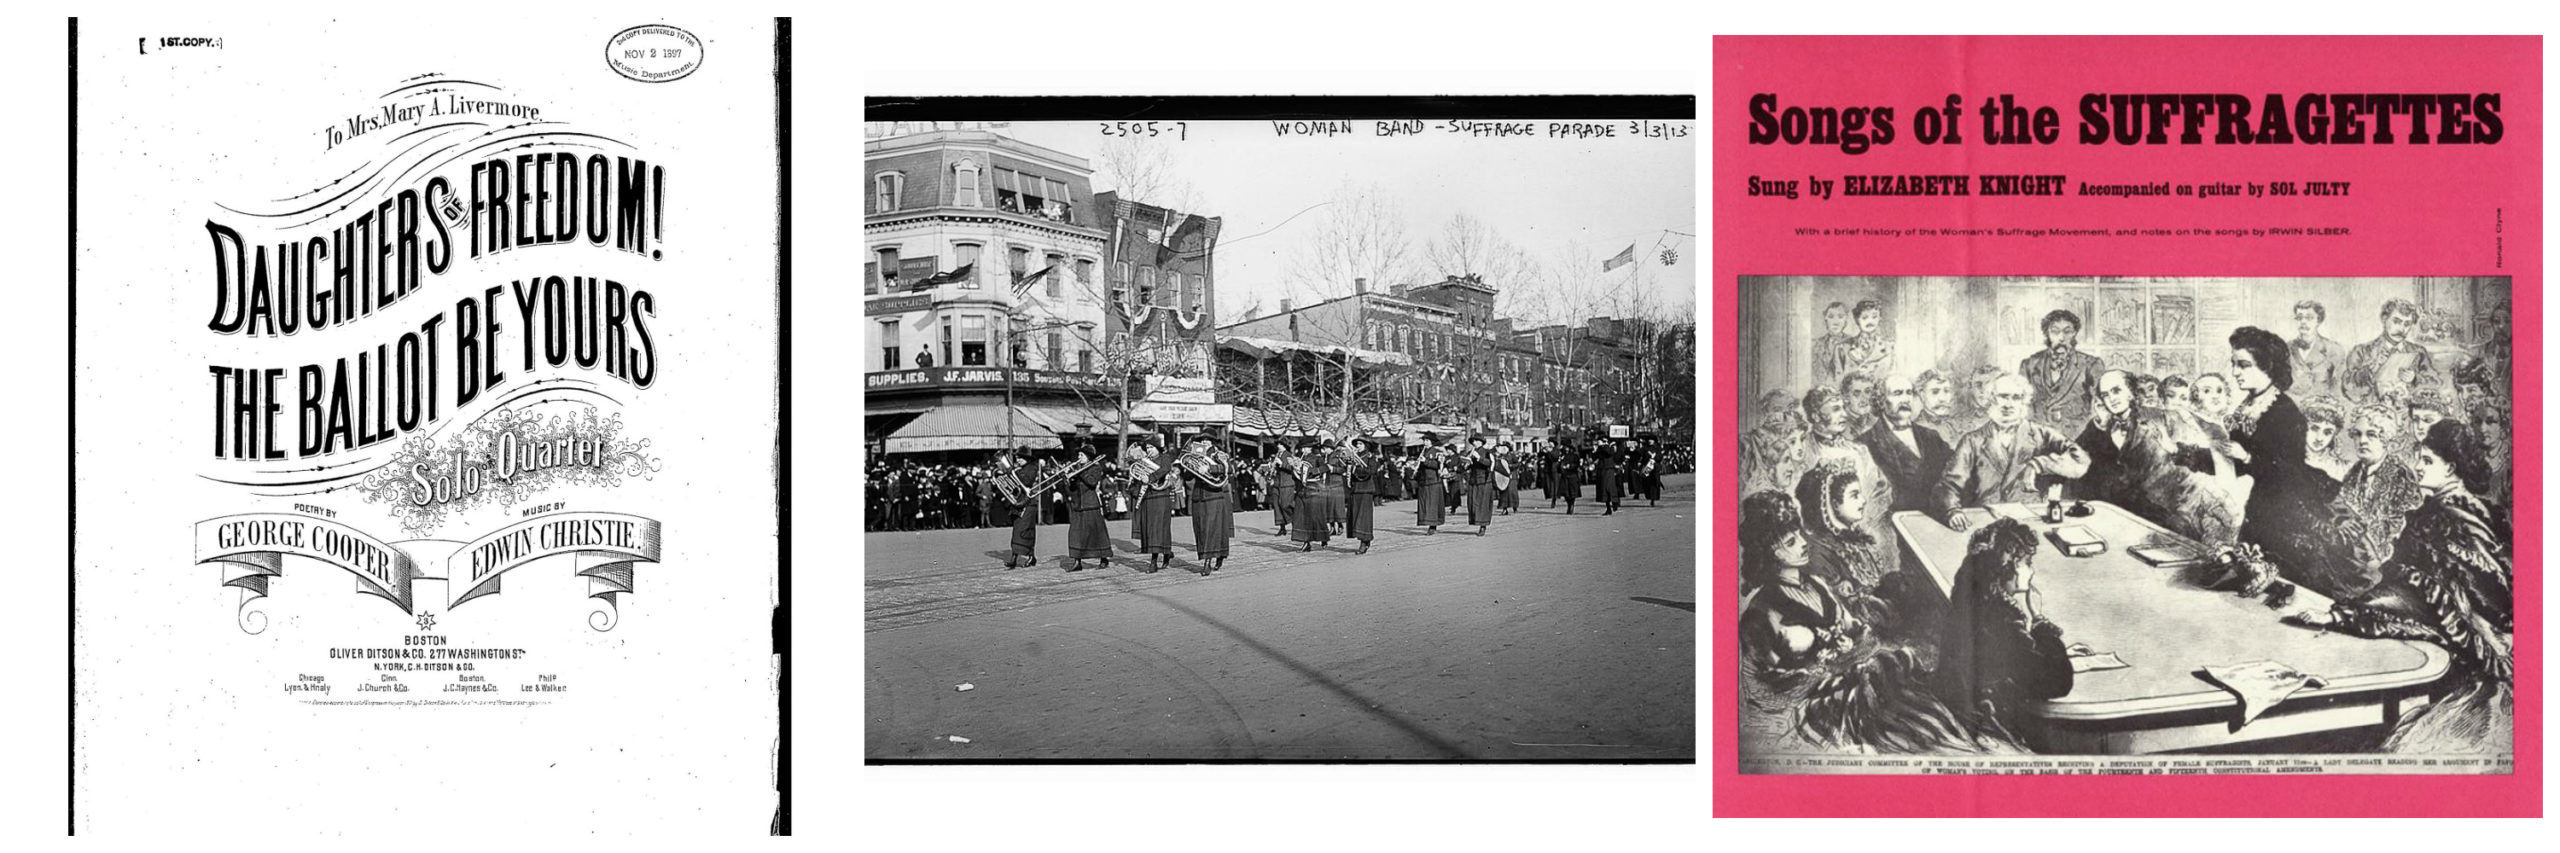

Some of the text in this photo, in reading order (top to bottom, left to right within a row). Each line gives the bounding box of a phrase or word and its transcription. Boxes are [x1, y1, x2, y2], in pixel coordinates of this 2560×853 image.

[642, 28, 675, 37] DELIVERED
[676, 32, 685, 40] TO
[685, 37, 695, 47] THE
[624, 49, 645, 59] NOV
[650, 48, 657, 58] 2
[613, 59, 638, 76] Music
[325, 126, 342, 150] To
[381, 103, 426, 127] Mary
[429, 96, 446, 117] A.
[449, 94, 543, 122] Livermore.
[1273, 119, 1353, 136] WOMAN
[1376, 119, 1424, 136] BAND
[1549, 122, 1616, 138] PARADE
[1748, 92, 2505, 155] Songs of the SUFFRAGETTES
[1100, 121, 1186, 141] 2505-7
[1748, 175, 2351, 200] Sung by ELIZABETH KNIGHT Accompanied on guitar by SOL JULTY
[1794, 228, 1820, 236] With
[1834, 228, 1860, 236] brief
[1863, 228, 1901, 238] history
[1904, 228, 1916, 236] of
[1919, 228, 1937, 236] the
[1940, 228, 1993, 236] Woman's
[1997, 228, 2046, 238] Suffrage
[2049, 228, 2112, 237] Movement,
[2115, 228, 2137, 236] and
[2193, 228, 2212, 236] the
[2215, 230, 2249, 238] songs
[2252, 228, 2267, 238] by
[2268, 228, 2302, 236] IRWIN
[205, 151, 666, 337] DAUGHTERS OF FREEDOM!
[209, 275, 656, 461] THE BALLOT BE YOURS
[411, 449, 480, 507] Solo
[498, 430, 603, 486] Quartet
[294, 503, 337, 518] POETRY BY
[522, 502, 566, 517] MUSIC BY
[218, 520, 305, 549] GEORGE
[471, 519, 641, 583] EDWIN CHRISTIE.
[404, 635, 447, 646] BOSTON
[329, 648, 364, 659] OLIVER
[429, 648, 446, 659] 277
[447, 648, 511, 659] WASHINGTON
[424, 663, 454, 671] DITSON
[456, 663, 462, 671] &
[299, 673, 325, 684] Chicago
[521, 684, 533, 692] Lee
[1868, 759, 1908, 767] COMMITTEE
[1947, 760, 1971, 768] HOUSE
[2346, 758, 2382, 766] DELEGATE
[2422, 758, 2437, 766] HER
[2020, 768, 2034, 776] THE
[2078, 768, 2093, 776] THE
[2149, 768, 2163, 776] AND
